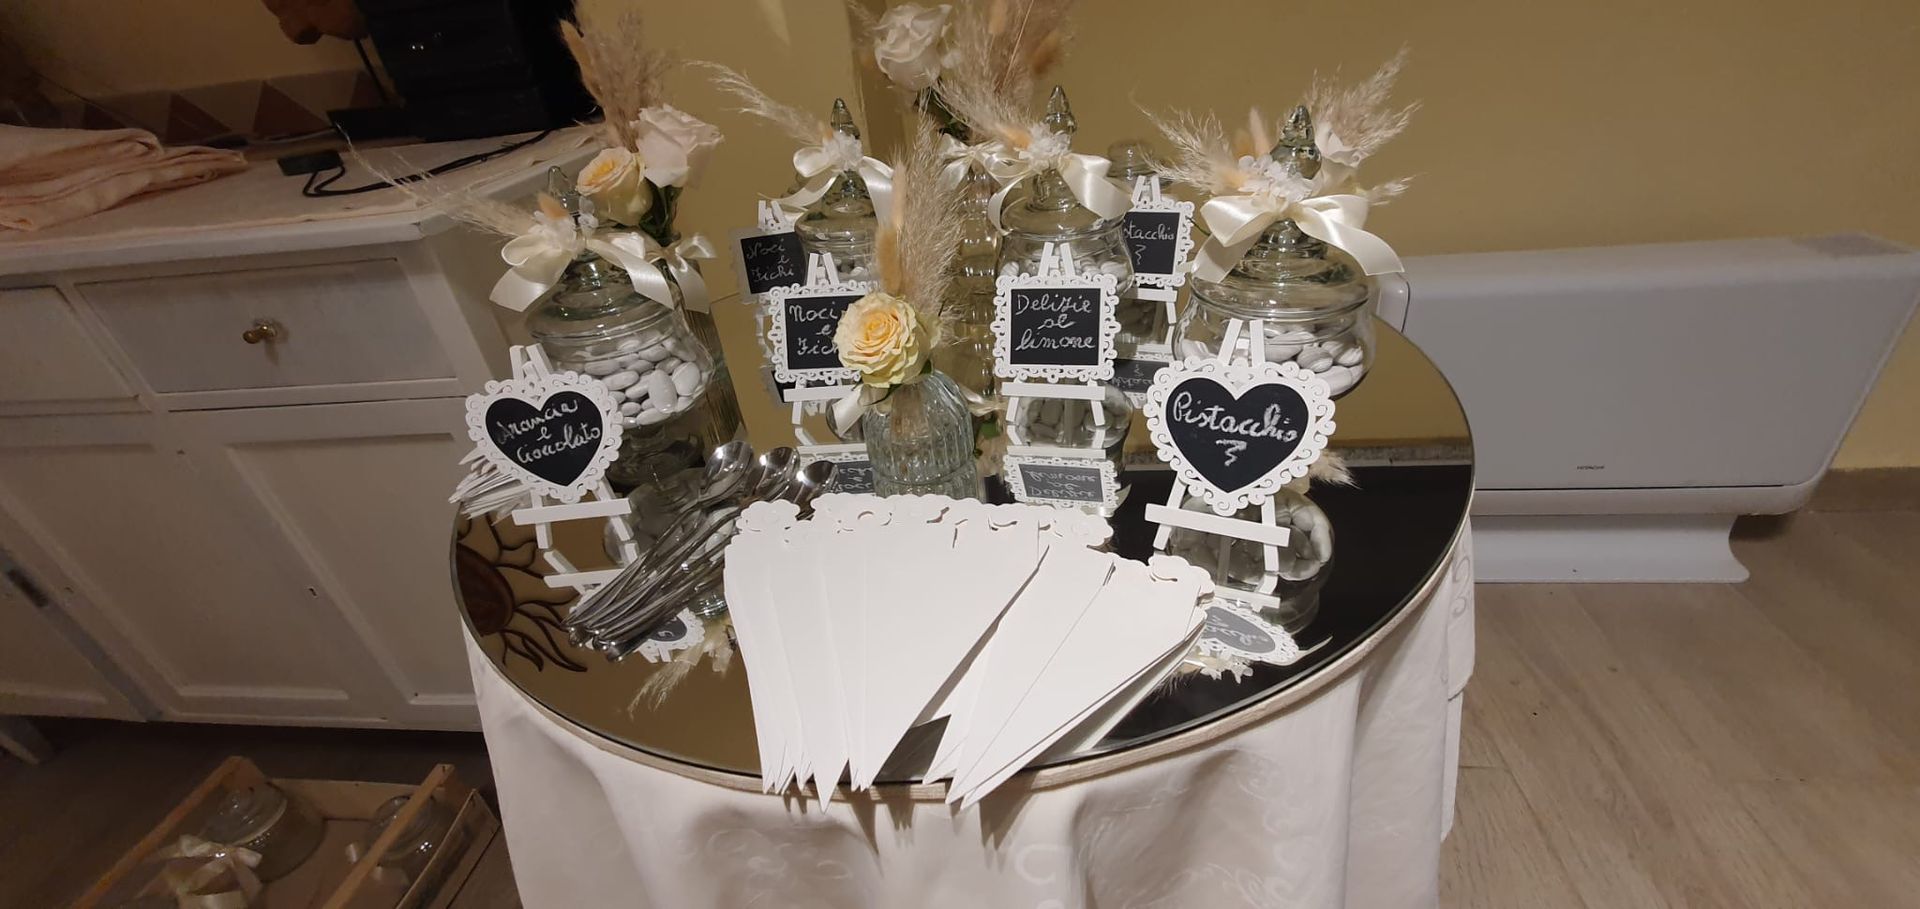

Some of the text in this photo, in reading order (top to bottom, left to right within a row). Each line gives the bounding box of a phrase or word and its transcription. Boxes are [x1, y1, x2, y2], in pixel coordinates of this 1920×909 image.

[1123, 219, 1175, 241] stacchio
[789, 301, 839, 322] Noci
[1015, 293, 1092, 315] Delizie
[815, 324, 832, 336] e
[1036, 313, 1076, 330] al
[1015, 328, 1096, 351] limone
[496, 399, 579, 445] Arancia
[1173, 391, 1298, 442] Pistacchio
[536, 426, 552, 441] e
